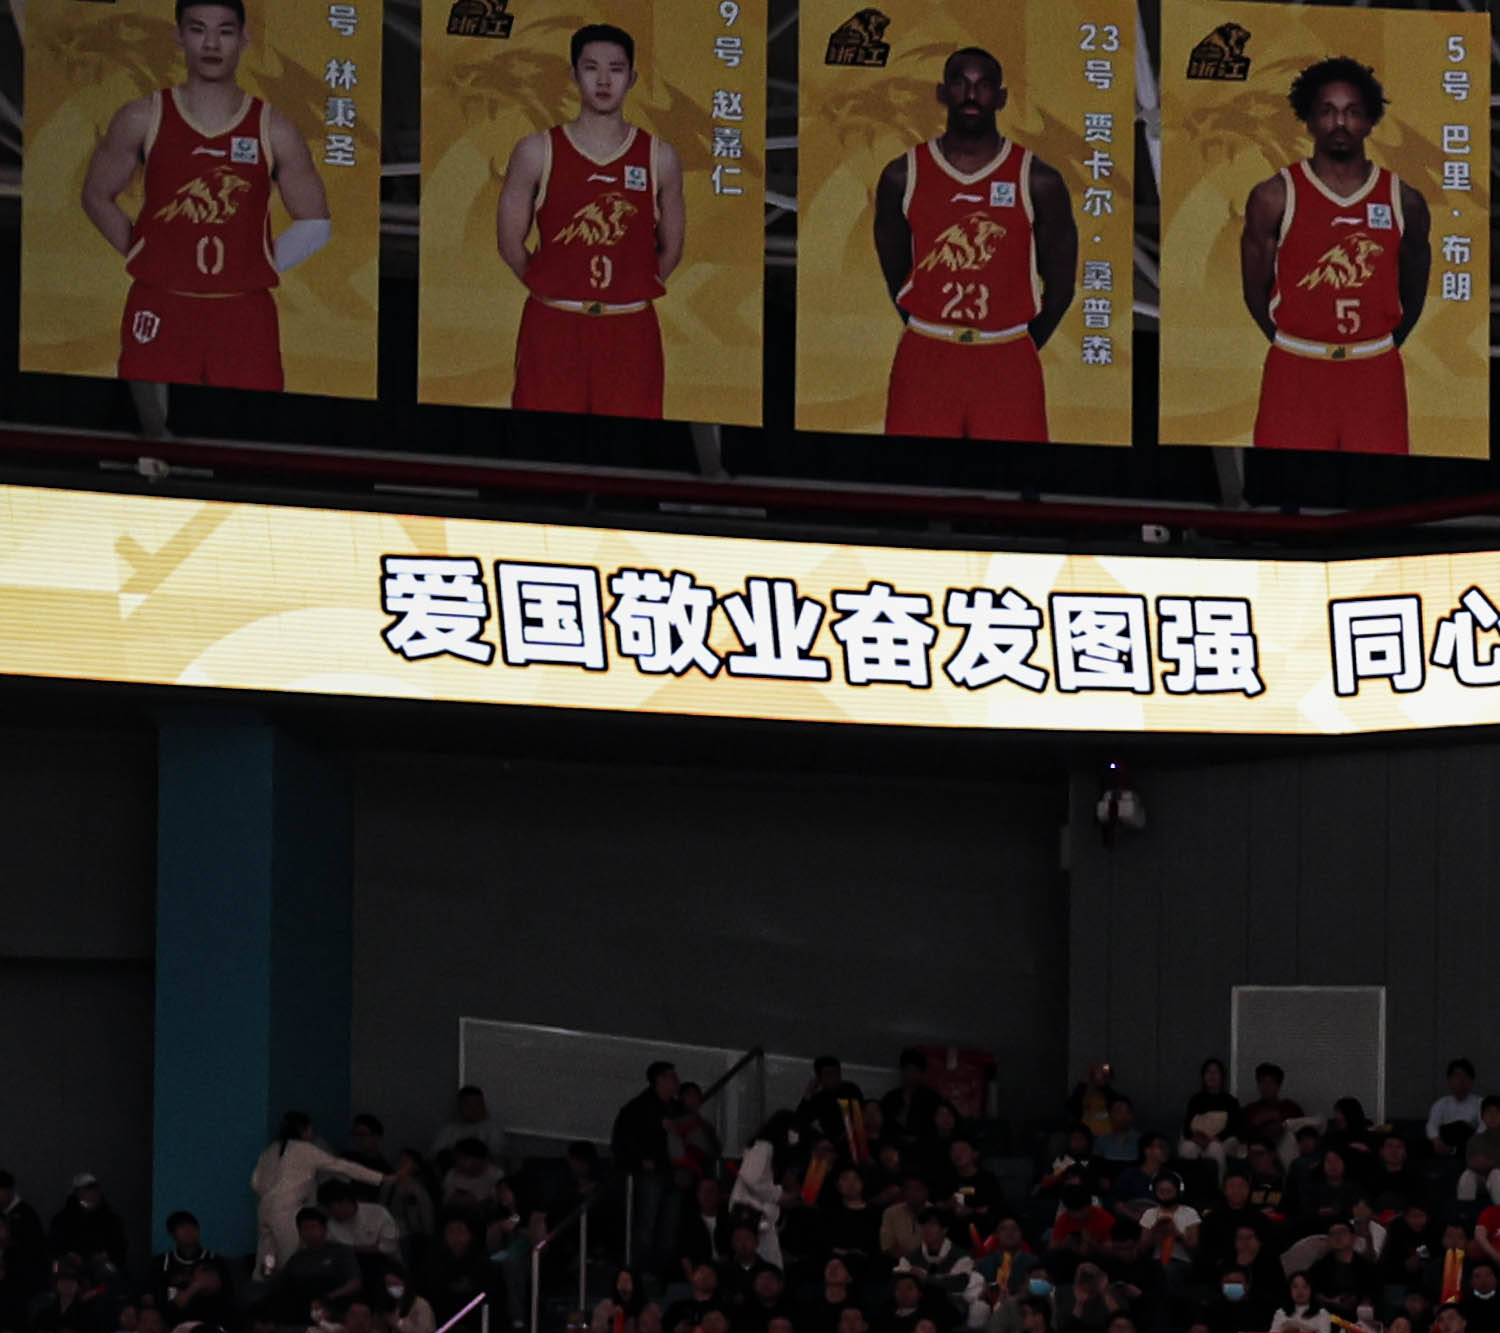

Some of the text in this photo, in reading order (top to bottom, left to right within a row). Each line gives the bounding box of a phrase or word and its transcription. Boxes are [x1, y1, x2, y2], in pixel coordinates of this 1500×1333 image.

[711, 0, 743, 194] 9号 赵嘉仁
[1079, 24, 1120, 364] 23号 贾卡尔·桑普森
[1441, 36, 1472, 301] 5号 巴里·布朗
[196, 235, 224, 274] 0
[590, 255, 612, 289] 9
[941, 282, 989, 320] 23
[1337, 299, 1361, 334] 5
[380, 555, 1264, 697] 爱国敬业奋发图强
